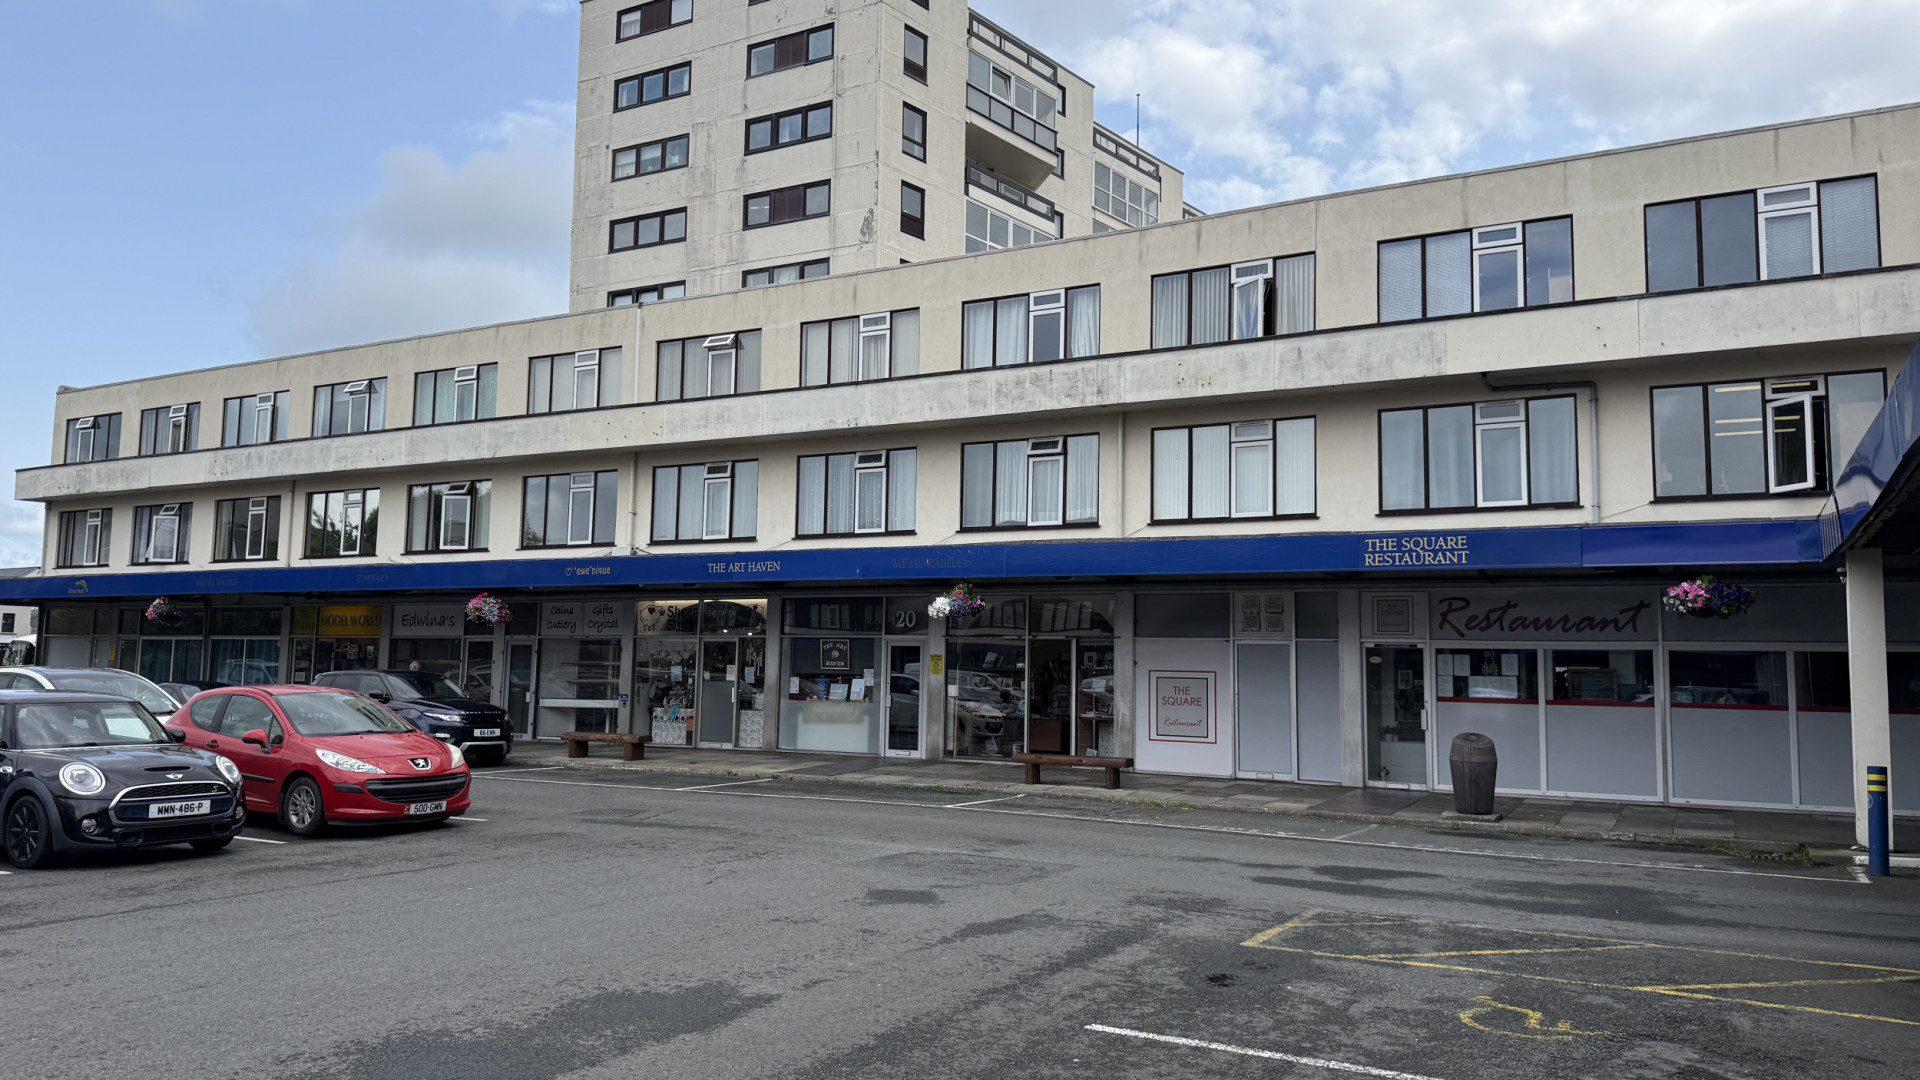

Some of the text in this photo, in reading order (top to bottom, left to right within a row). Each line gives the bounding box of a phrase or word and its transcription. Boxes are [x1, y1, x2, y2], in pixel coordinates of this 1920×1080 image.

[1365, 536, 1468, 553] THE SQUARE
[893, 558, 968, 569] MEMORABILIA
[1364, 551, 1470, 567] RESTAURANT
[707, 561, 781, 573] THE ART HAVEN
[550, 606, 574, 615] China
[592, 605, 614, 617] Gifts
[667, 605, 699, 620] Sheep
[1438, 596, 1652, 638] Restaurant
[321, 614, 348, 627] MODEL
[350, 614, 382, 627] WORLD
[401, 611, 455, 627] Edwina's
[895, 610, 917, 628] 20
[546, 619, 577, 633] Cutlery
[587, 619, 618, 633] Crystal
[836, 642, 847, 651] ART
[1173, 685, 1191, 696] THE
[1161, 696, 1203, 707] SQUARE
[1163, 717, 1203, 728] Restaurant
[157, 802, 203, 816] MMN-486-P
[414, 801, 444, 814] 500-GMN
